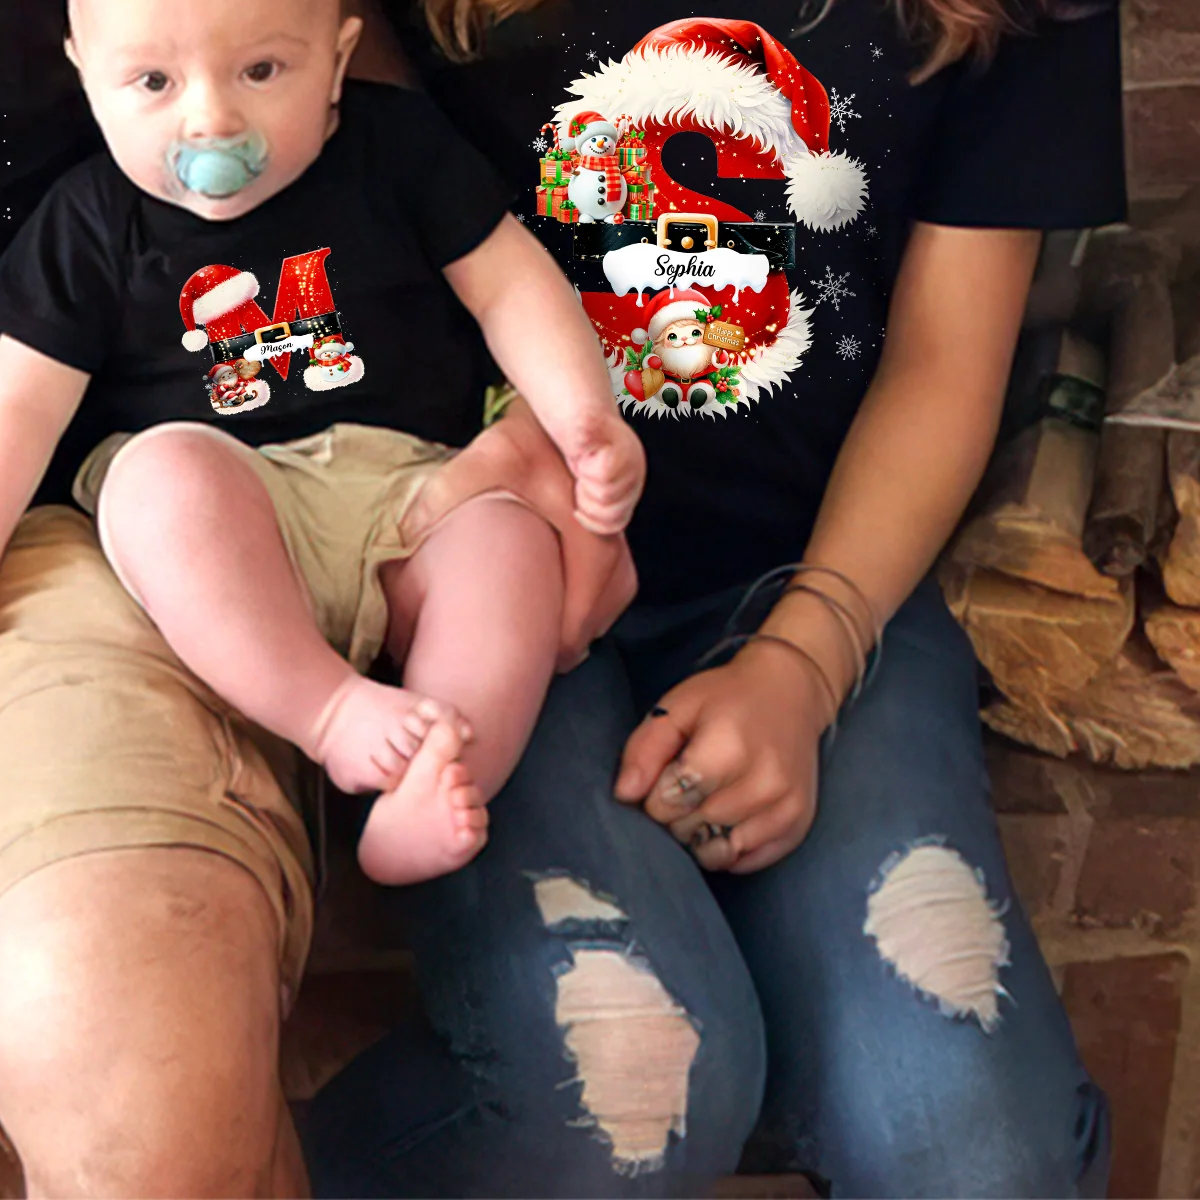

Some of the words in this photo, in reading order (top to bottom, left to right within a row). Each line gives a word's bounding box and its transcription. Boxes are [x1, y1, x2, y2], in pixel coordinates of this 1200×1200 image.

[654, 254, 716, 285] Sophia
[707, 333, 740, 346] Christmas
[260, 342, 294, 355] Mason
